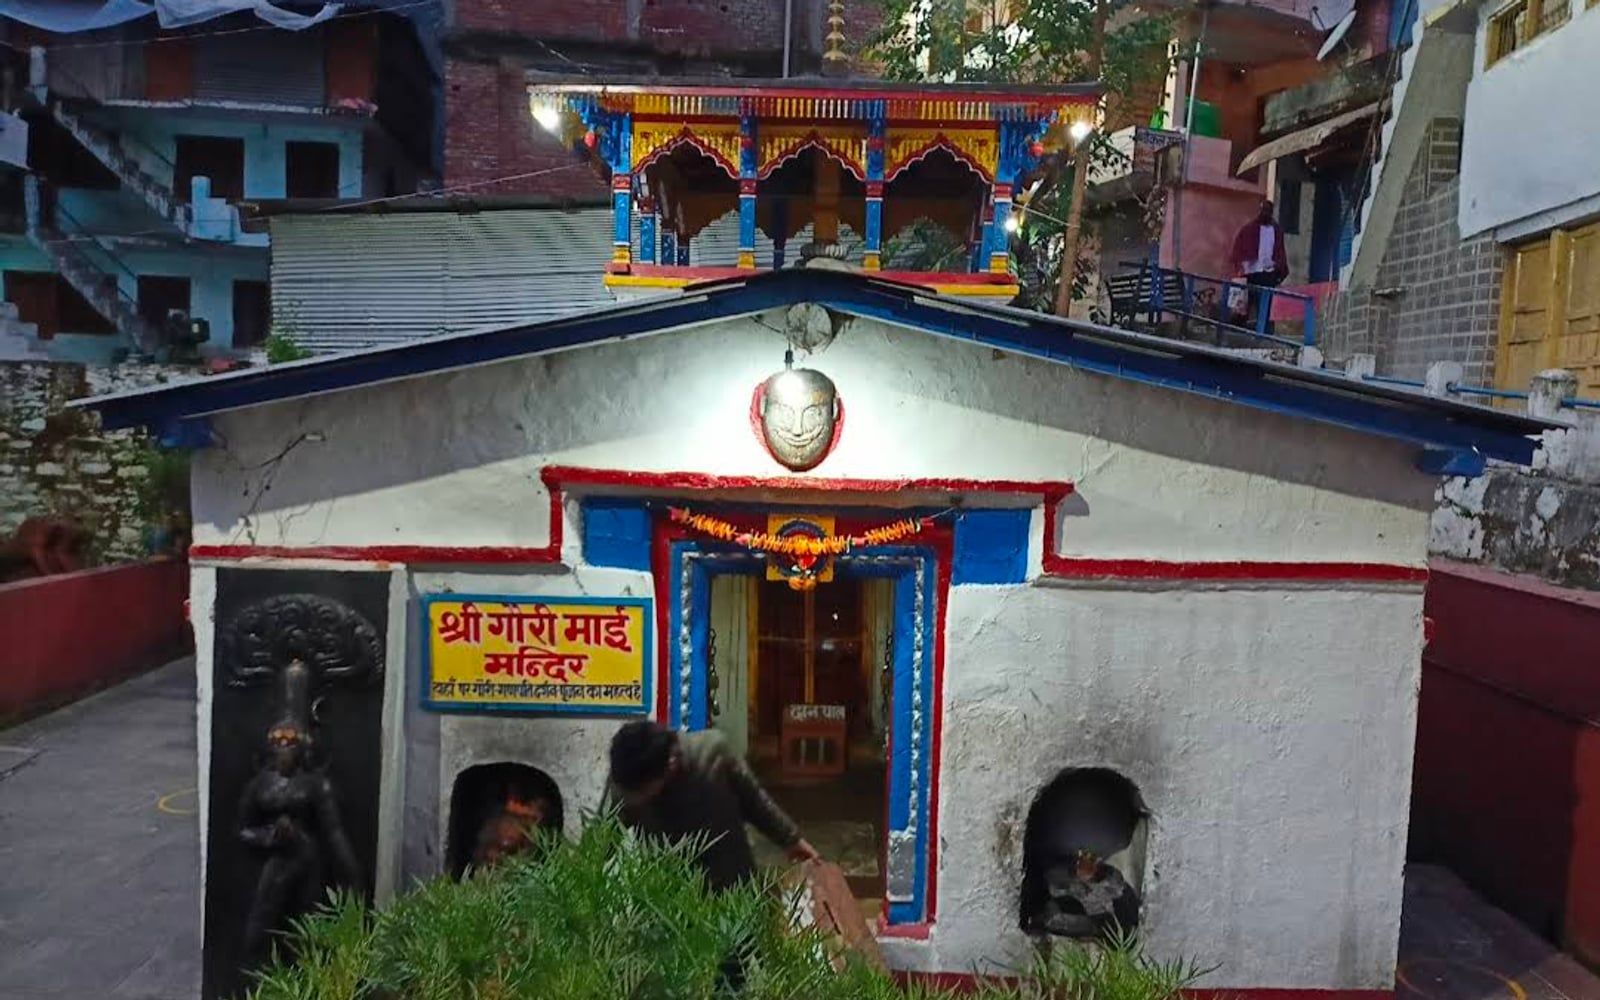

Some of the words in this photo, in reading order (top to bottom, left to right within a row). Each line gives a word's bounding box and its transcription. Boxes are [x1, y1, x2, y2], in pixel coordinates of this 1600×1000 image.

[438, 602, 483, 644] श्री
[487, 602, 558, 646] गौरी
[563, 605, 632, 652] माई
[484, 646, 589, 683] मन्दिर
